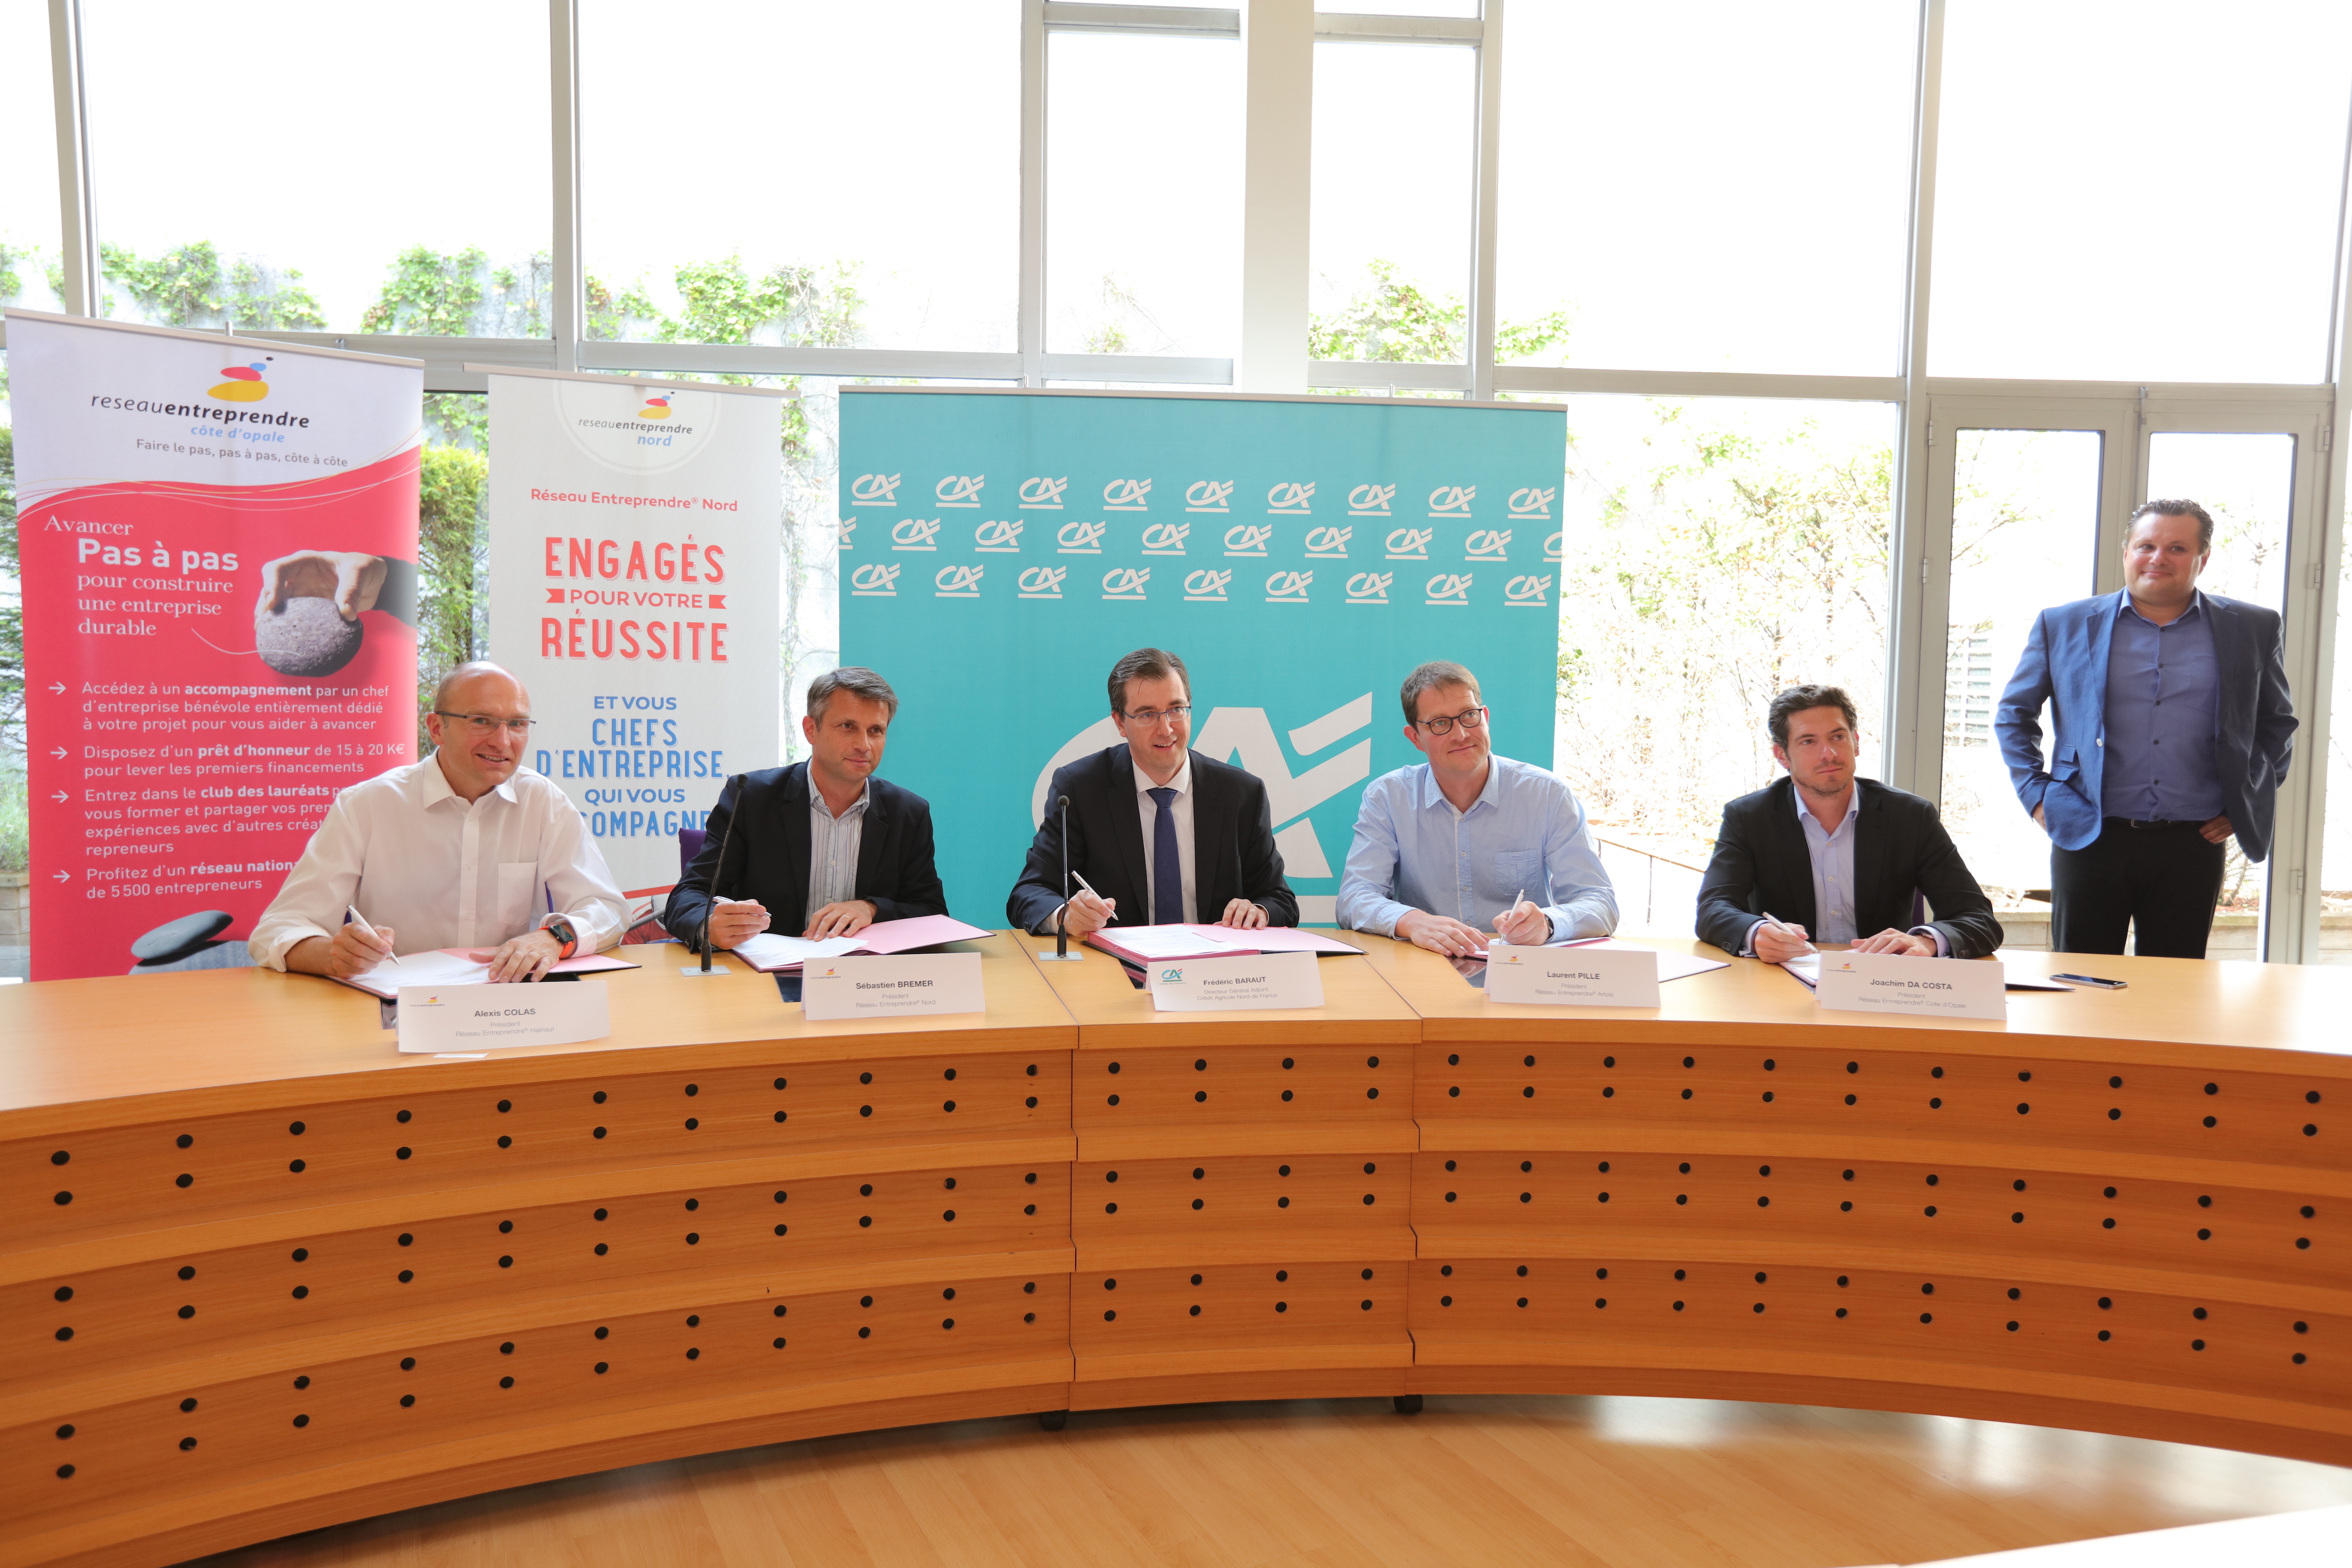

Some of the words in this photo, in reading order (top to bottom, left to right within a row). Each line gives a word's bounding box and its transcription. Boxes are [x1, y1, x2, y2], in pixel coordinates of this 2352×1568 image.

[92, 396, 309, 428] reseauentreprendre
[191, 425, 223, 437] côte
[579, 420, 692, 434] reseauentreprendre
[638, 435, 672, 446] nord
[137, 439, 169, 451] Faire
[174, 443, 185, 453] le
[190, 446, 215, 457] pas,
[220, 449, 241, 458] pas
[245, 448, 251, 458] à
[256, 452, 280, 462] pas,
[285, 453, 309, 463] côte
[314, 454, 319, 464] à
[324, 456, 347, 466] côte
[532, 489, 586, 502] Réseau
[703, 499, 737, 511] Nord
[44, 515, 133, 535] Avancer
[78, 538, 141, 566] Pas
[152, 541, 169, 567] à
[182, 551, 238, 574] pas
[546, 534, 724, 585] ENGAGÉS
[77, 575, 126, 591] pour
[132, 578, 233, 593] construire
[571, 590, 629, 605] POUR
[633, 592, 702, 608] VOTRE
[78, 599, 116, 611] une
[121, 599, 222, 618] entreprise
[78, 618, 156, 635] durable
[542, 609, 727, 663] RÉUSSITE
[82, 682, 145, 694] Accédez
[149, 682, 158, 695] à
[163, 686, 180, 694] un
[185, 685, 313, 698] accompagnement
[316, 688, 338, 699] par
[363, 685, 389, 696] chef
[185, 700, 250, 712] bénévole
[255, 701, 342, 713] entièrement
[347, 701, 383, 713] dédié
[594, 696, 618, 709] ET
[621, 697, 677, 710] VOUS
[83, 717, 92, 730] à
[97, 719, 137, 730] votre
[143, 718, 187, 733] projet
[192, 721, 226, 732] pour
[230, 721, 264, 729] vous
[269, 718, 306, 729] aider
[310, 718, 318, 729] à
[592, 718, 678, 747] CHEFS
[85, 746, 155, 761] Disposez
[198, 744, 229, 759] prêt
[315, 744, 331, 756] de
[337, 744, 352, 755] 15
[356, 744, 364, 755] à
[368, 744, 383, 755] 20
[387, 744, 406, 754] K€
[85, 767, 122, 779] pour
[127, 764, 165, 775] lever
[170, 763, 191, 775] les
[197, 762, 263, 777] premiers
[268, 762, 364, 773] financements
[85, 789, 136, 801] Entrez
[142, 788, 178, 800] dans
[183, 787, 196, 799] le
[201, 786, 233, 798] club
[237, 786, 264, 797] des
[268, 784, 329, 796] lauréats
[585, 789, 621, 806] QUI
[626, 789, 685, 803] VOUS
[85, 810, 122, 819] vous
[127, 806, 181, 818] former
[185, 805, 199, 816] et
[204, 804, 268, 818] partager
[272, 805, 296, 813] vos
[86, 824, 180, 840] expériences
[185, 824, 218, 834] avec
[580, 811, 710, 838] OMPAGN
[86, 844, 174, 858] repreneurs
[87, 868, 148, 880] Profitez
[191, 862, 242, 875] réseau
[87, 887, 106, 898] de
[155, 880, 262, 895] entrepreneurs
